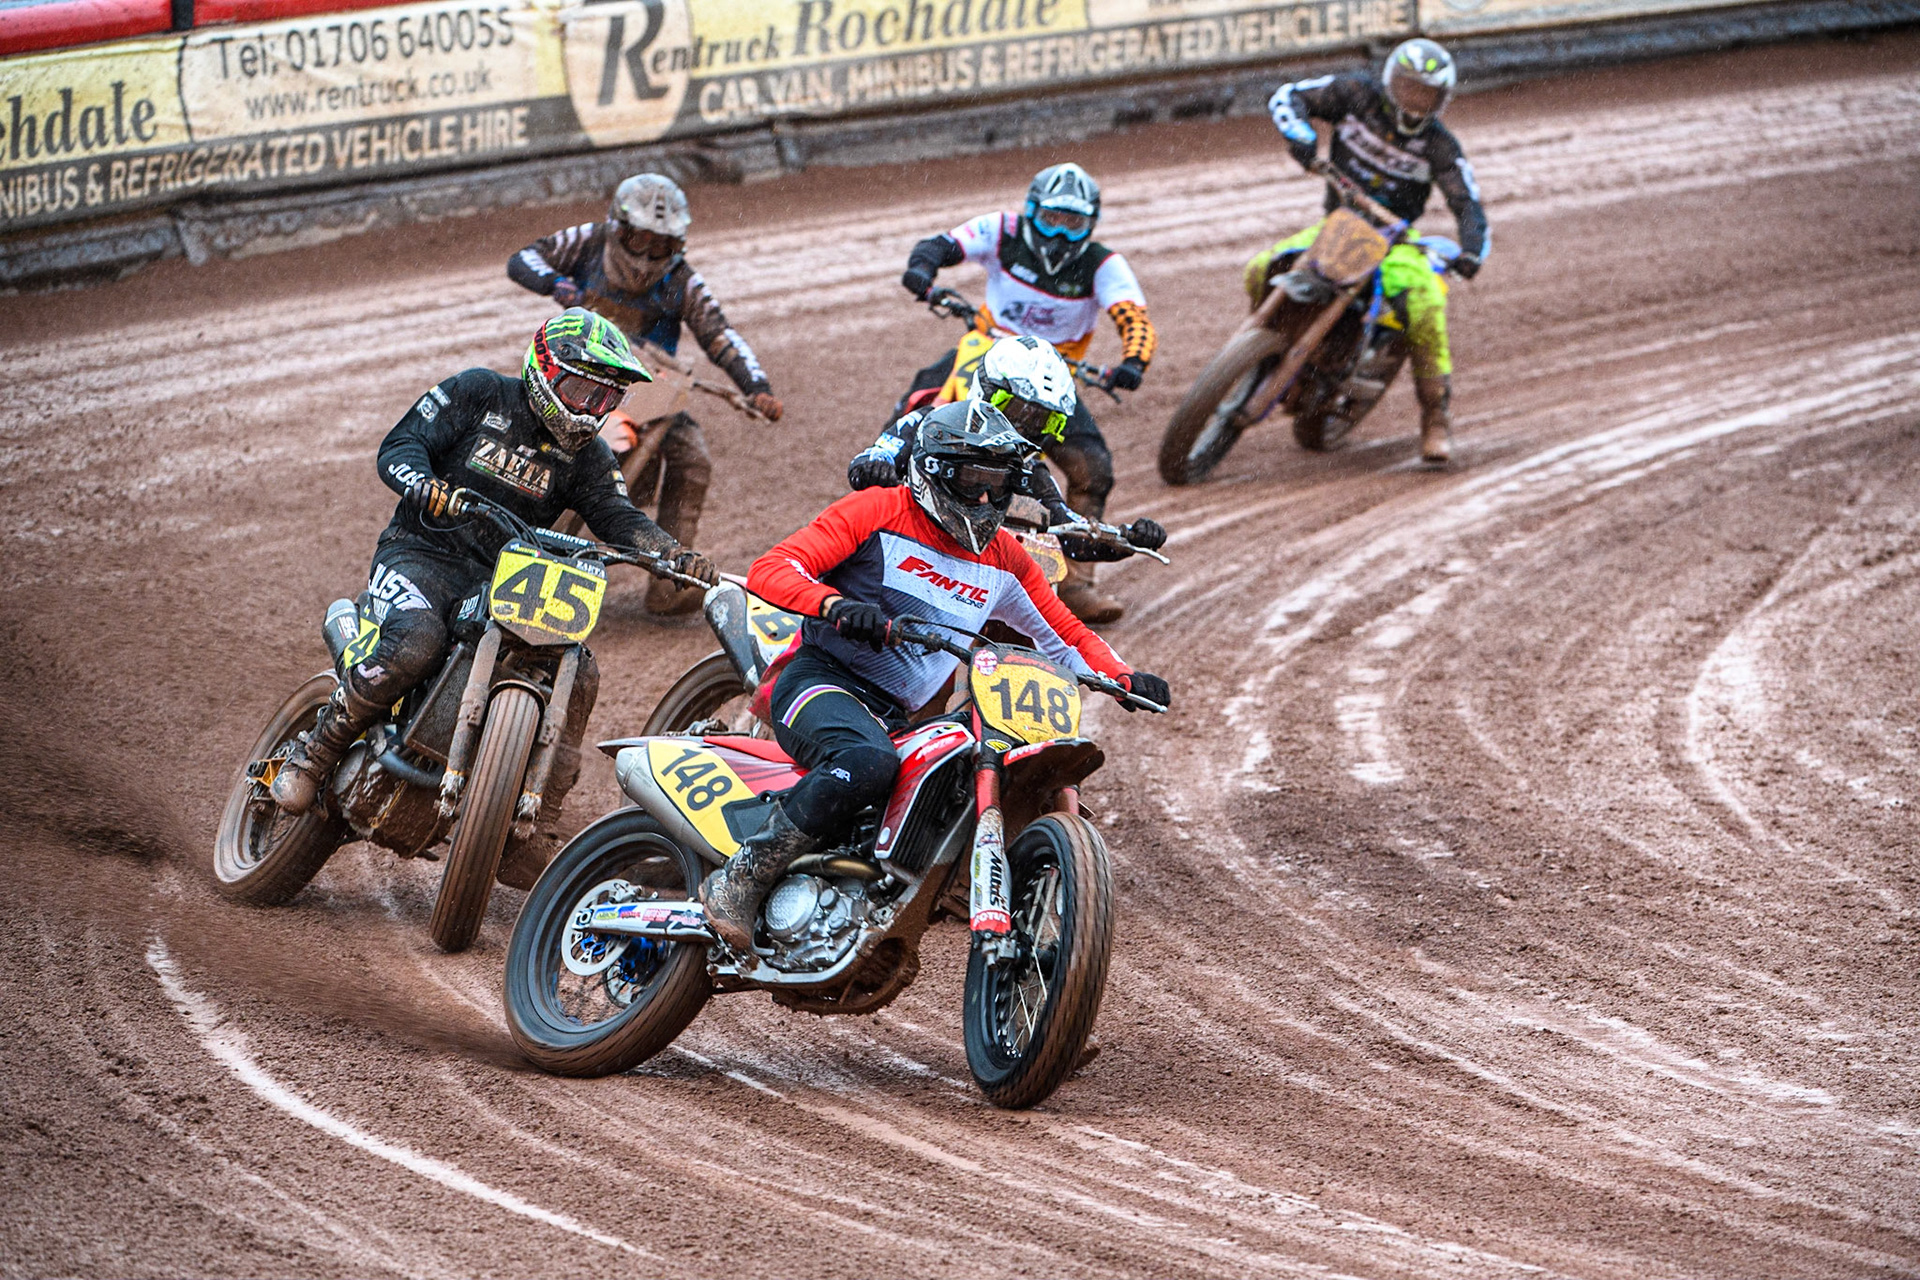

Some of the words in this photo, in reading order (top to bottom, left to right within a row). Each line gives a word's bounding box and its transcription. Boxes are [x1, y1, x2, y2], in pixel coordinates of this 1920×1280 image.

[286, 19, 388, 72] 01706
[399, 7, 515, 58] 640055
[789, 0, 1058, 57] Rochdale
[246, 60, 494, 119] www.rentruck.co.uk
[847, 48, 976, 104] MINIBUS
[1003, 23, 1224, 84] REFRIGERATED
[0, 79, 158, 162] hdale
[86, 162, 105, 208] &
[110, 131, 326, 202] REFRIGERATED
[331, 114, 459, 172] VEHICLE
[461, 105, 531, 152] HIRE
[475, 439, 551, 490] ZAETA
[536, 527, 590, 547] domino
[493, 562, 590, 633] 45
[896, 555, 990, 603] FANTIC
[950, 593, 985, 609] RACING
[990, 678, 1072, 734] 148
[661, 748, 733, 811] 148
